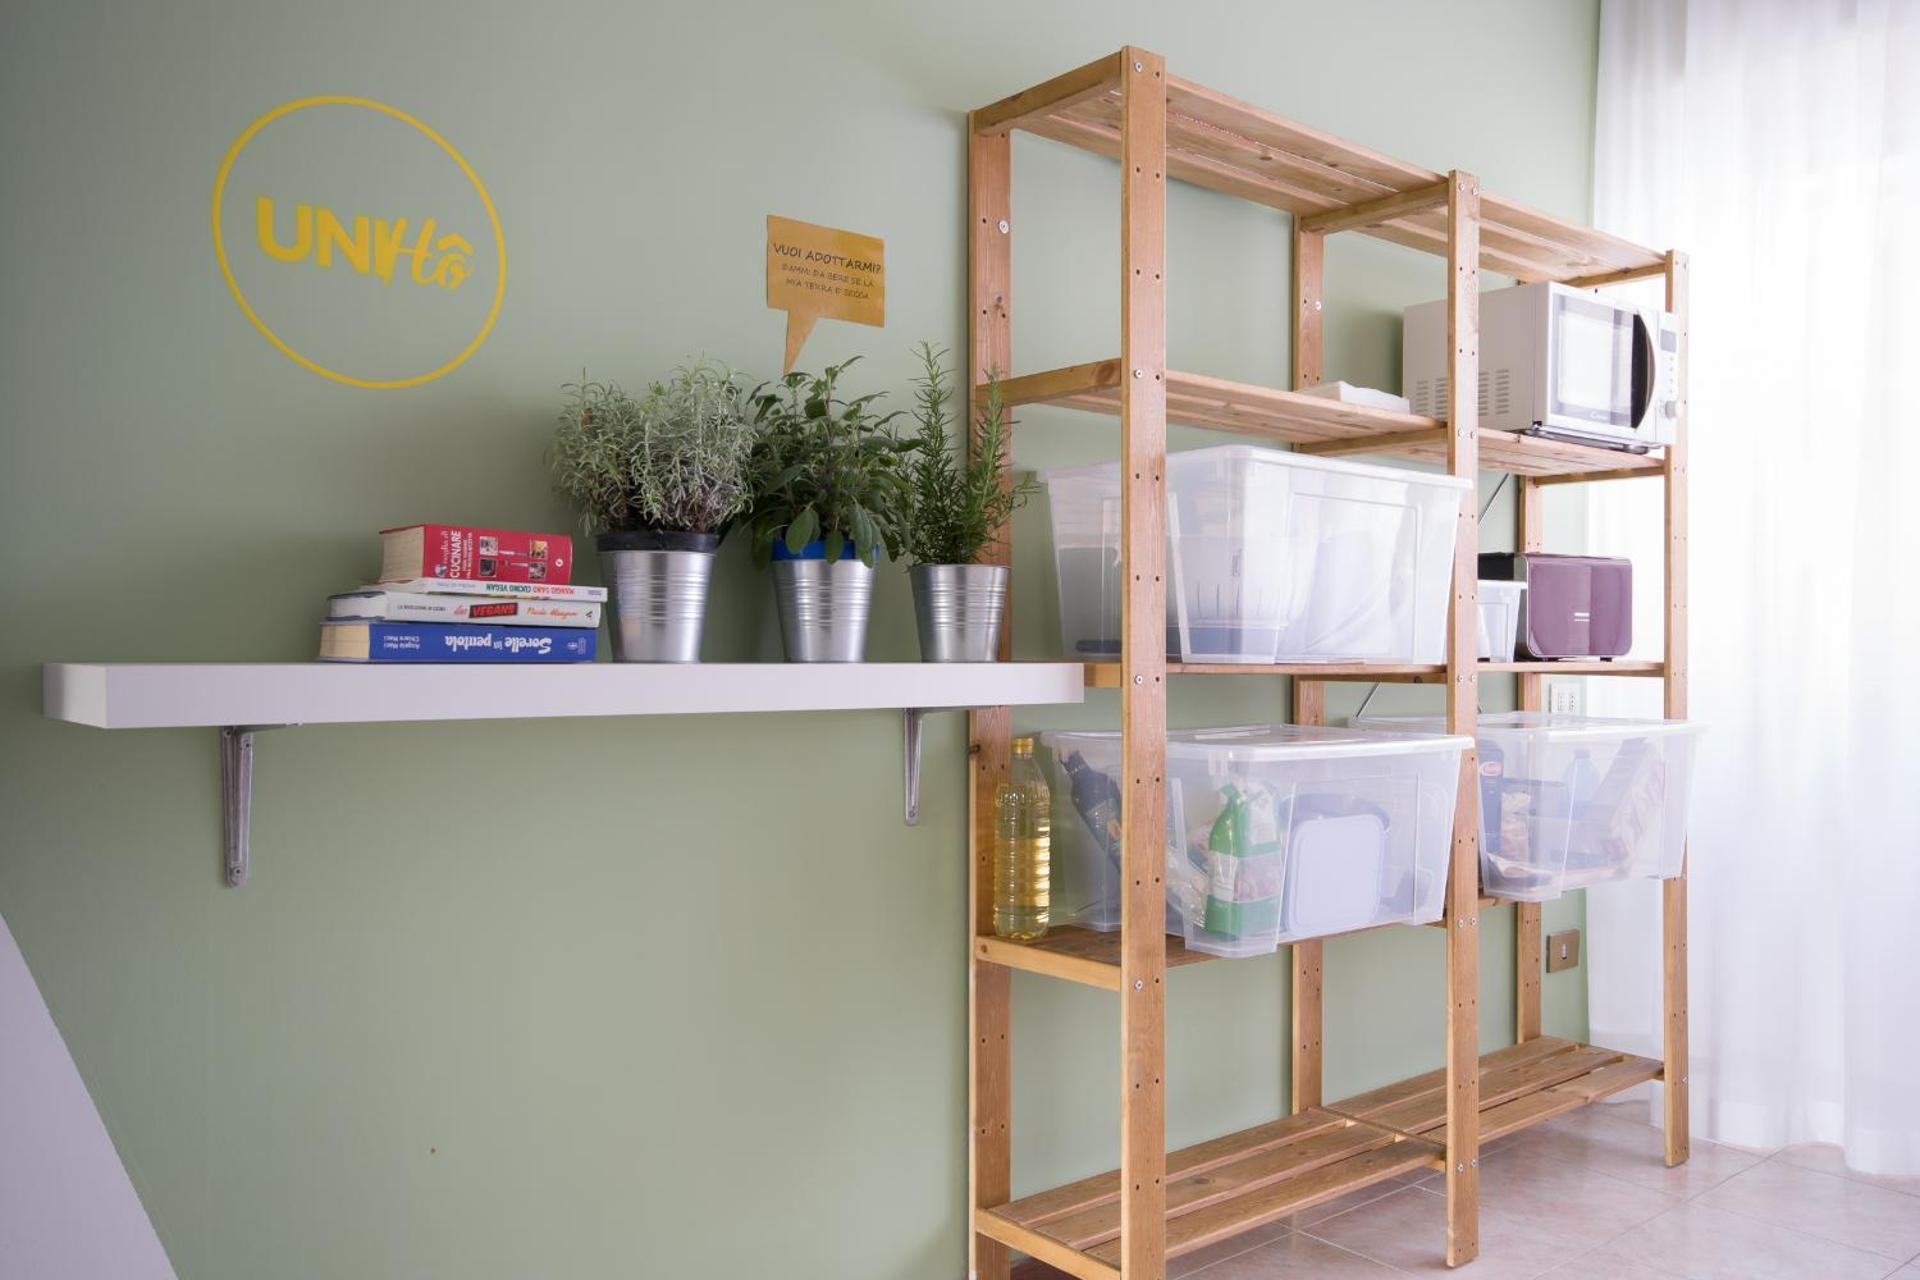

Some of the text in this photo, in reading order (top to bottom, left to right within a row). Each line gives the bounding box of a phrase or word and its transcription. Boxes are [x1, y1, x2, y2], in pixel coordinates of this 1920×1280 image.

[774, 243, 882, 274] VUOI ADOTTARMI?
[450, 530, 462, 578] CUCINARE
[485, 582, 508, 593] VEGAN
[508, 584, 532, 594] CUCINO
[444, 634, 492, 652] pentola
[505, 636, 552, 655] Sorelle
